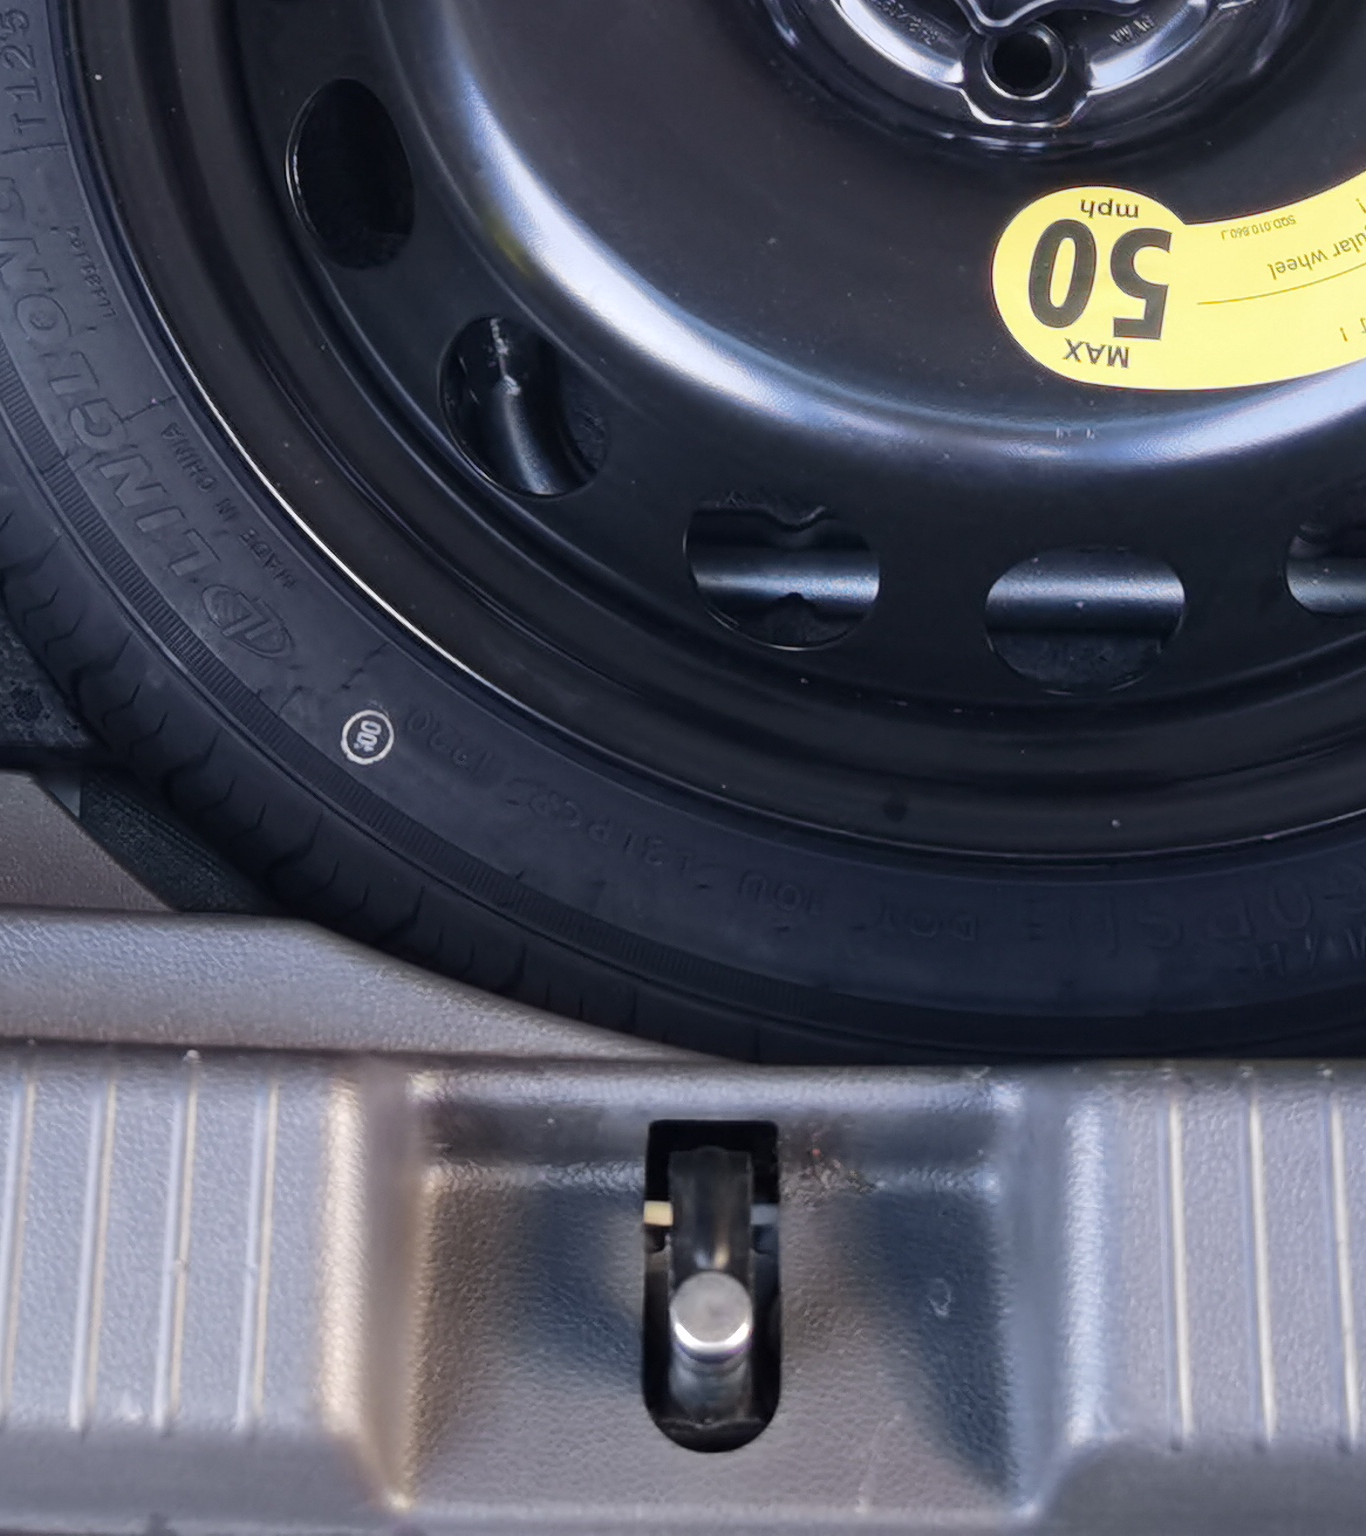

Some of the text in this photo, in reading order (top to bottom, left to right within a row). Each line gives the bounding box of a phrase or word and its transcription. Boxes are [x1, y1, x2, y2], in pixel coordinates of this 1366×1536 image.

[1079, 200, 1140, 222] mph
[1030, 219, 1174, 341] 50
[1266, 248, 1329, 282] wheel
[1062, 338, 1131, 369] MAX
[156, 419, 219, 493] CHINA
[236, 525, 302, 591] MADE
